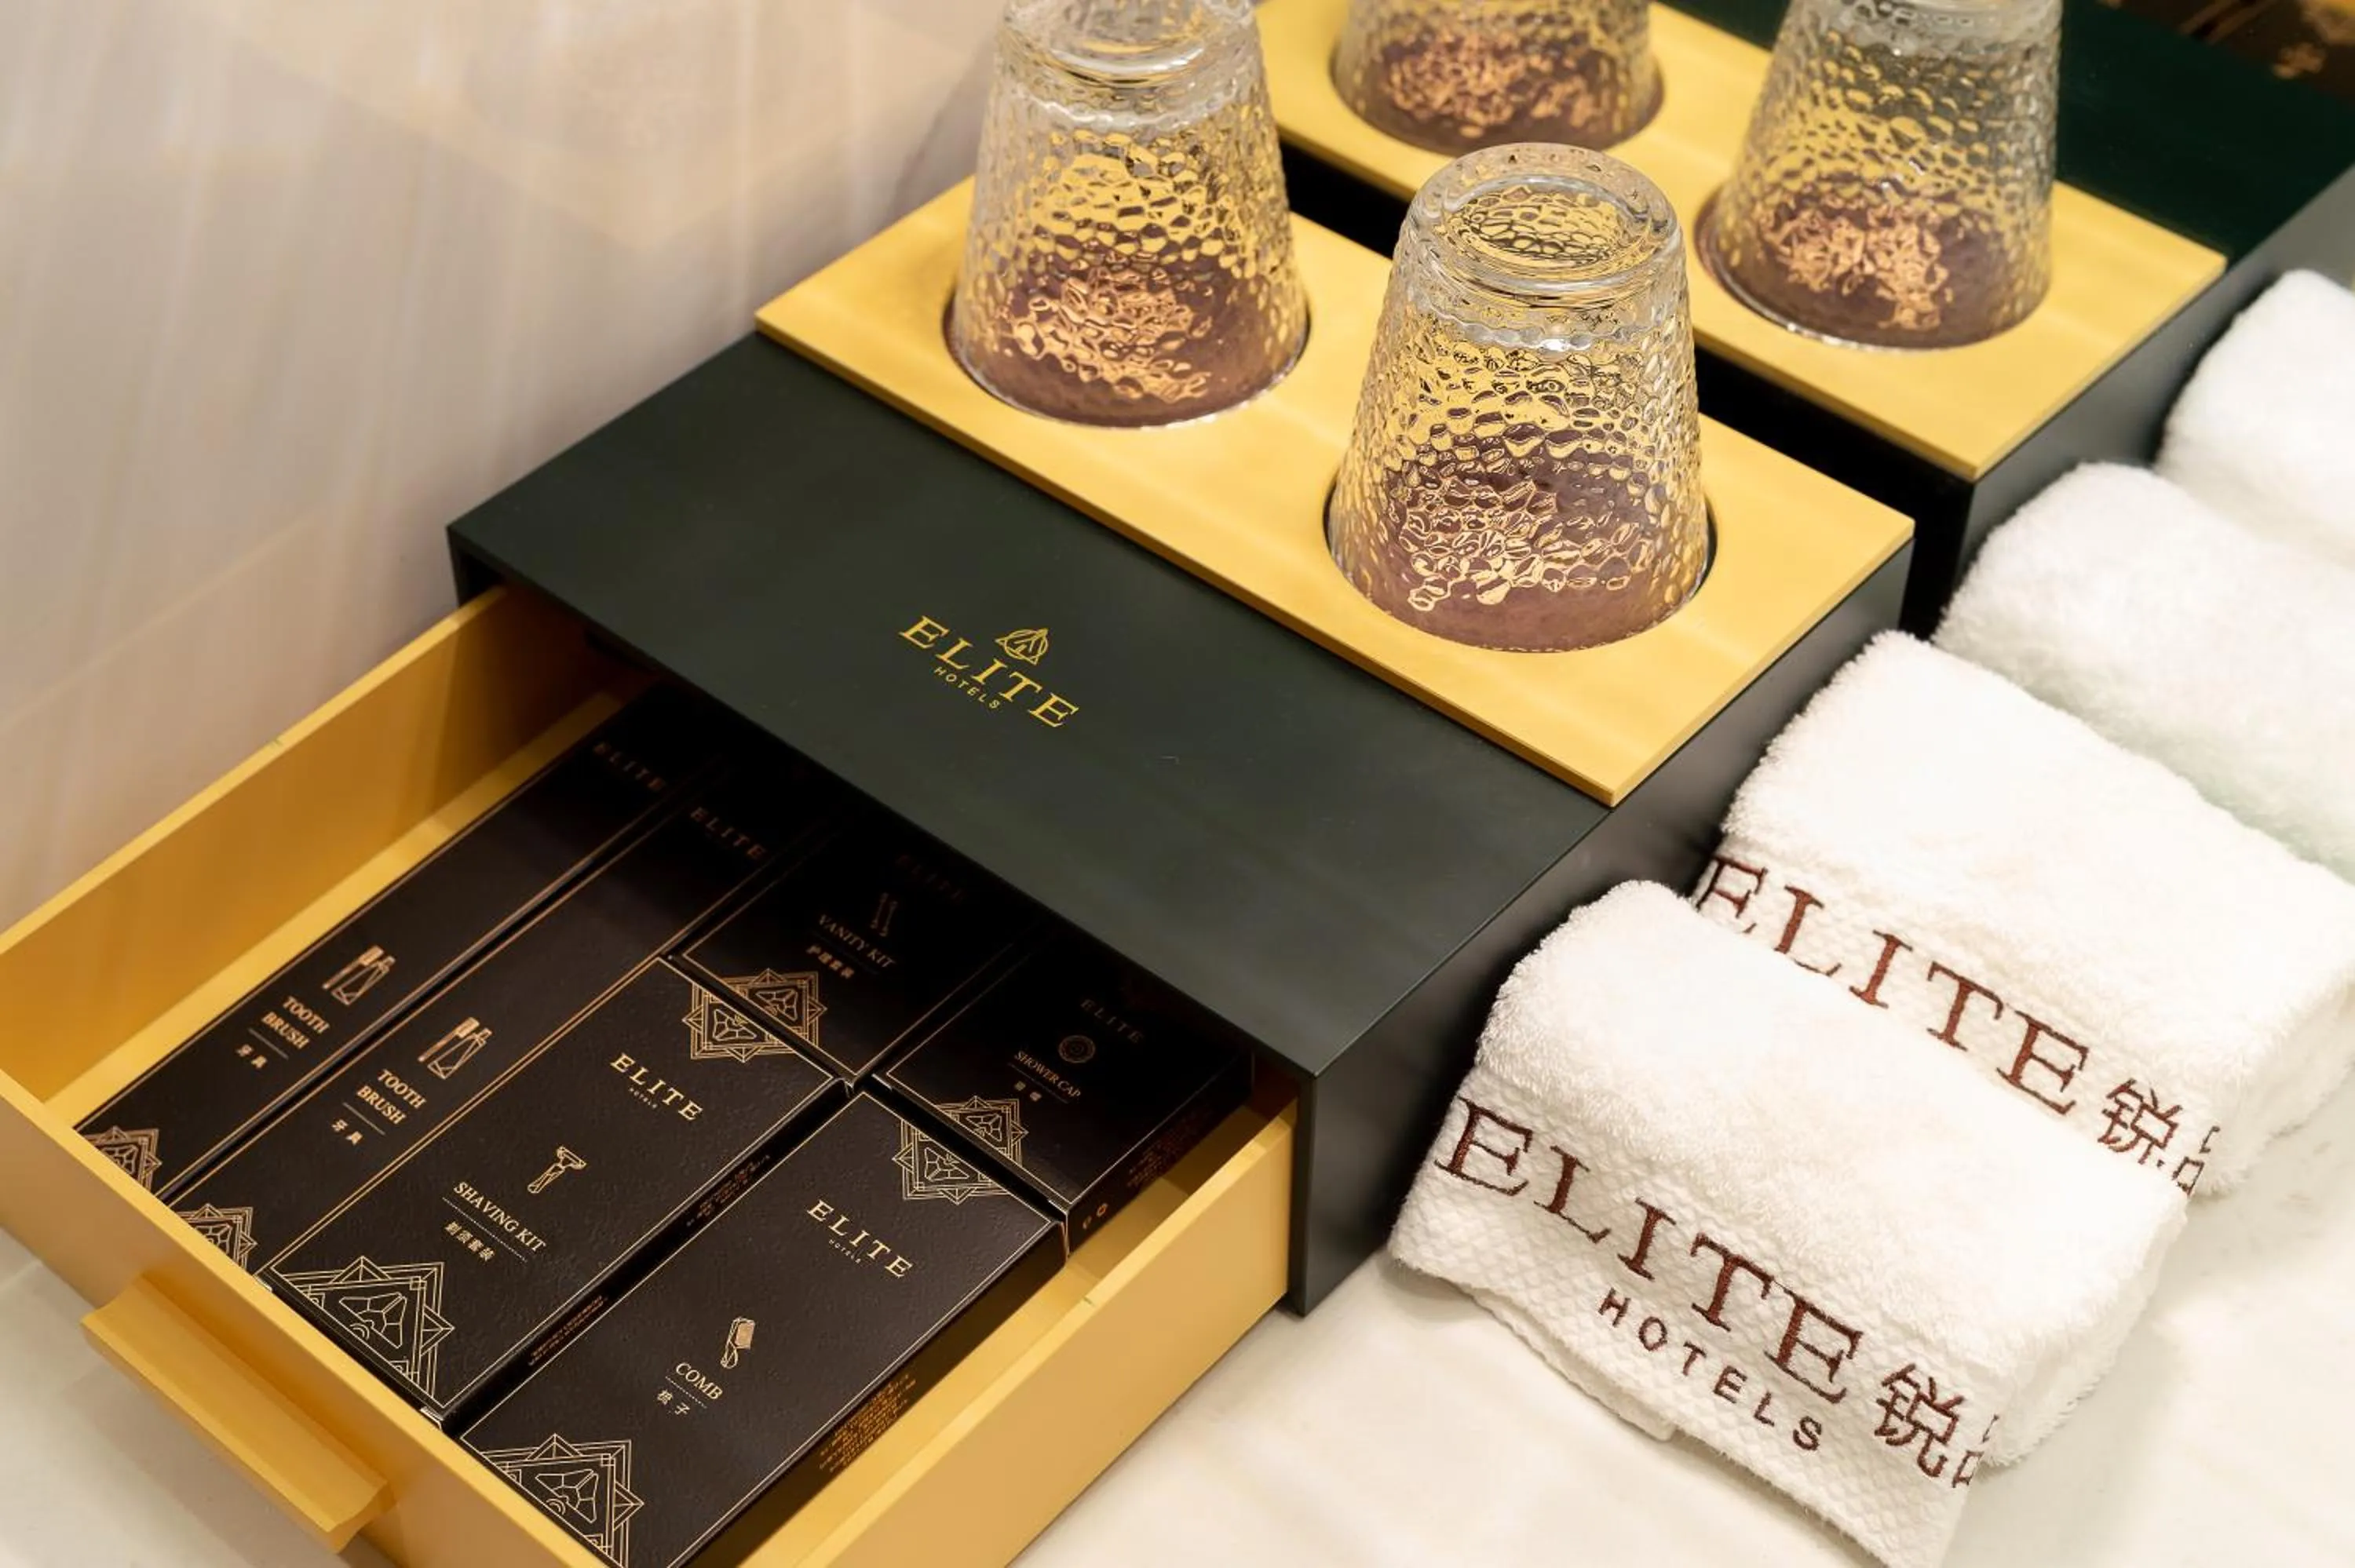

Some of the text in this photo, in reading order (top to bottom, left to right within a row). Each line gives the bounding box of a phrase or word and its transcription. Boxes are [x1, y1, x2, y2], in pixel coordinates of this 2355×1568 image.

[898, 615, 1079, 727] ELITE
[933, 667, 1000, 709] HOTELS
[690, 807, 769, 861] ELITE
[819, 913, 897, 968] VANITY KIT
[1696, 855, 2089, 1115] ELITE
[261, 1012, 310, 1049] BRUSH
[283, 996, 330, 1034] TOOTH
[1079, 997, 1145, 1044] ELITE
[377, 1069, 426, 1109] TOOTH
[609, 1052, 703, 1121] ELITE
[1014, 1049, 1059, 1085] SHOWER
[1057, 1080, 1083, 1099] CAP
[356, 1085, 407, 1125] BRUSH
[454, 1181, 546, 1253] SHAVING KIT
[807, 1199, 913, 1278] ELITE
[1433, 1096, 1864, 1404] ELITE
[675, 1362, 723, 1400] COMB
[1598, 1288, 1822, 1453] HOTELS
